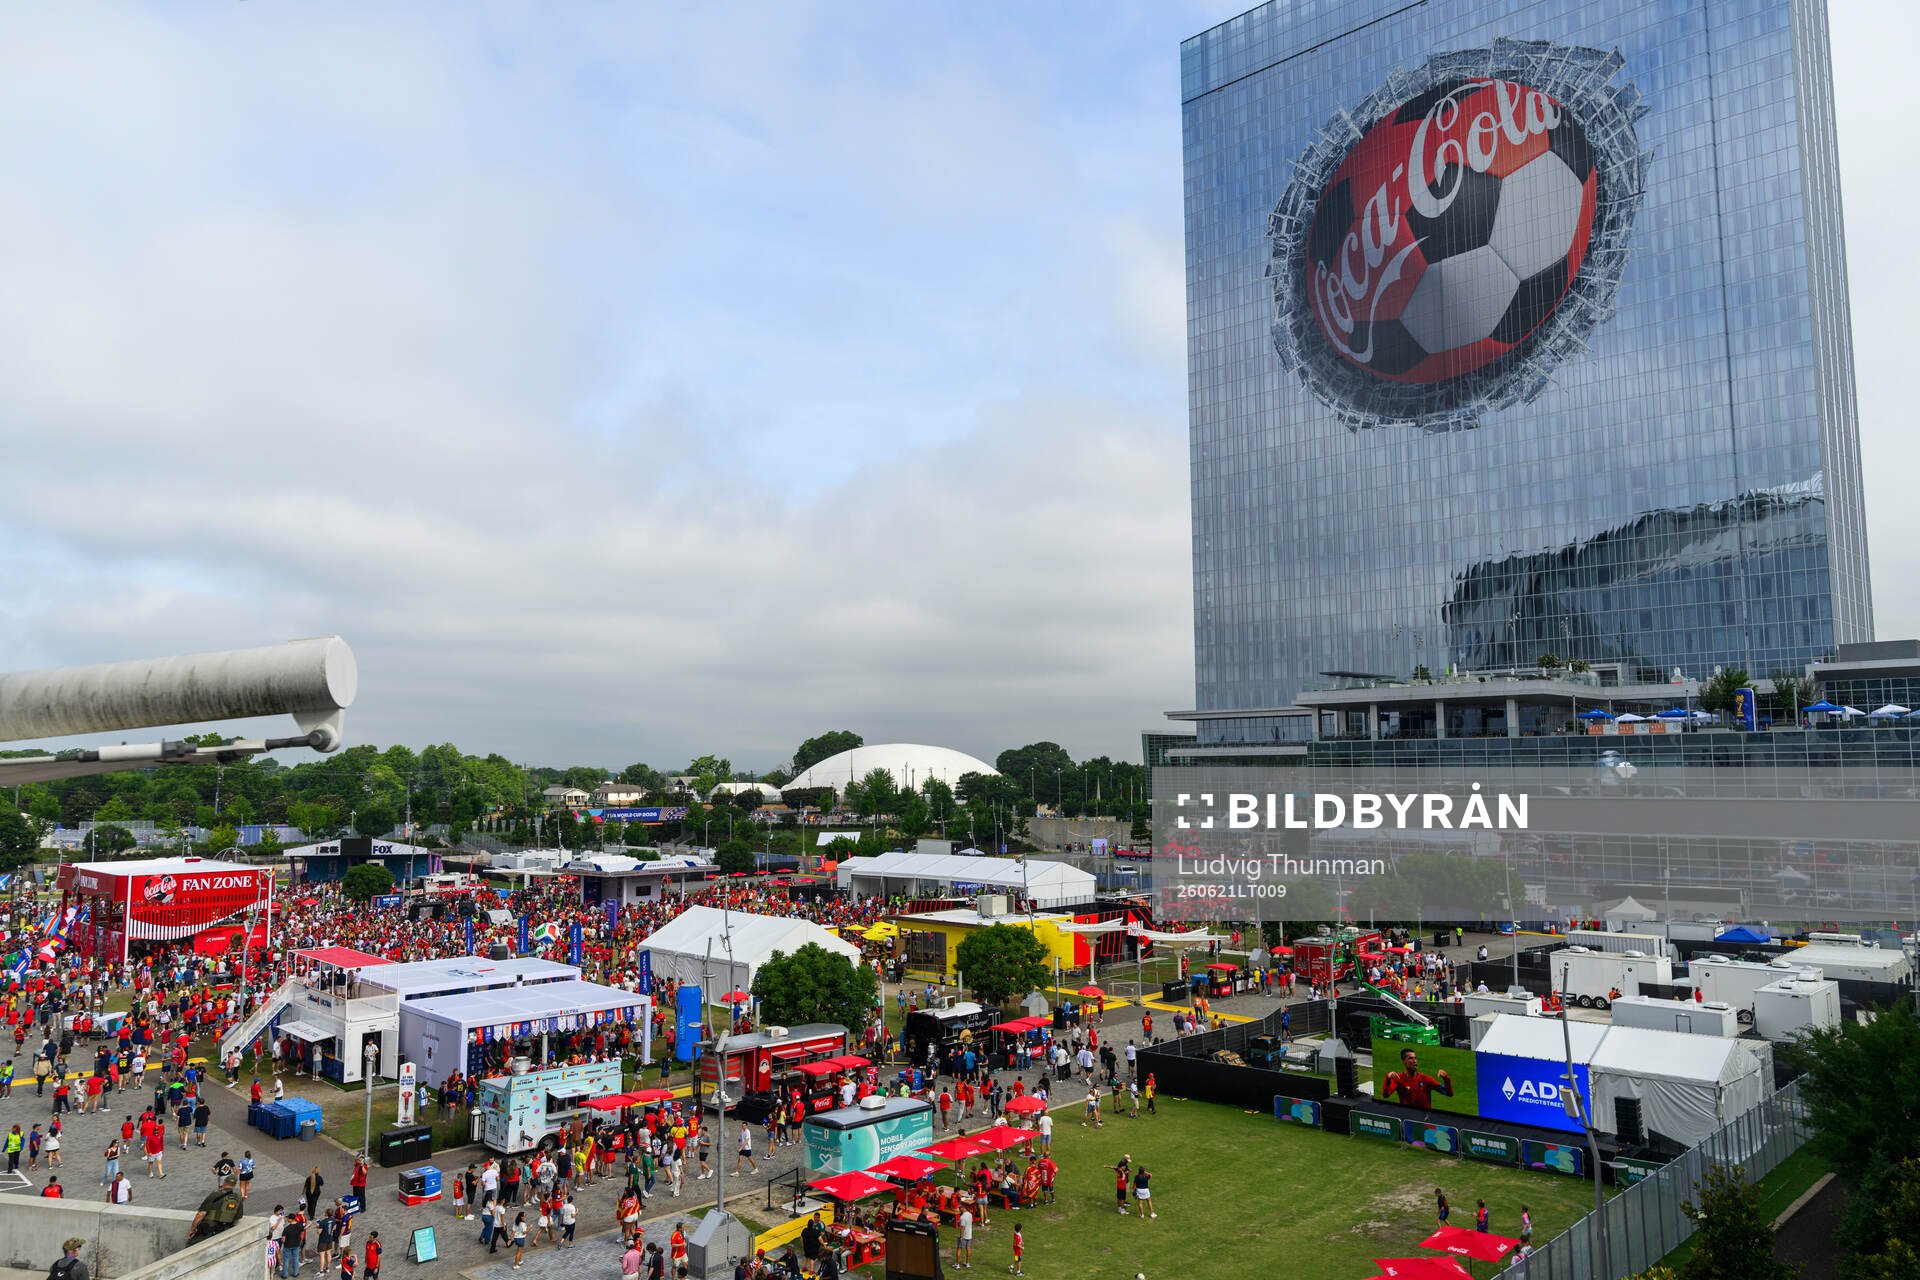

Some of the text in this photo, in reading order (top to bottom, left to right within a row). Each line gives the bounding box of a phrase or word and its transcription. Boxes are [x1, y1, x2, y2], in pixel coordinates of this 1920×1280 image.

[1314, 78, 1561, 363] Coca-Cola
[372, 845, 393, 854] FOX
[144, 875, 178, 900] Coca-Cola
[182, 876, 252, 891] FAN ZONE
[1360, 1125, 1391, 1135] ATLANTA
[881, 1133, 904, 1145] MOBILE
[1471, 1137, 1486, 1147] WE
[880, 1143, 907, 1154] SENSORY
[1471, 1145, 1507, 1156] ATLANTA
